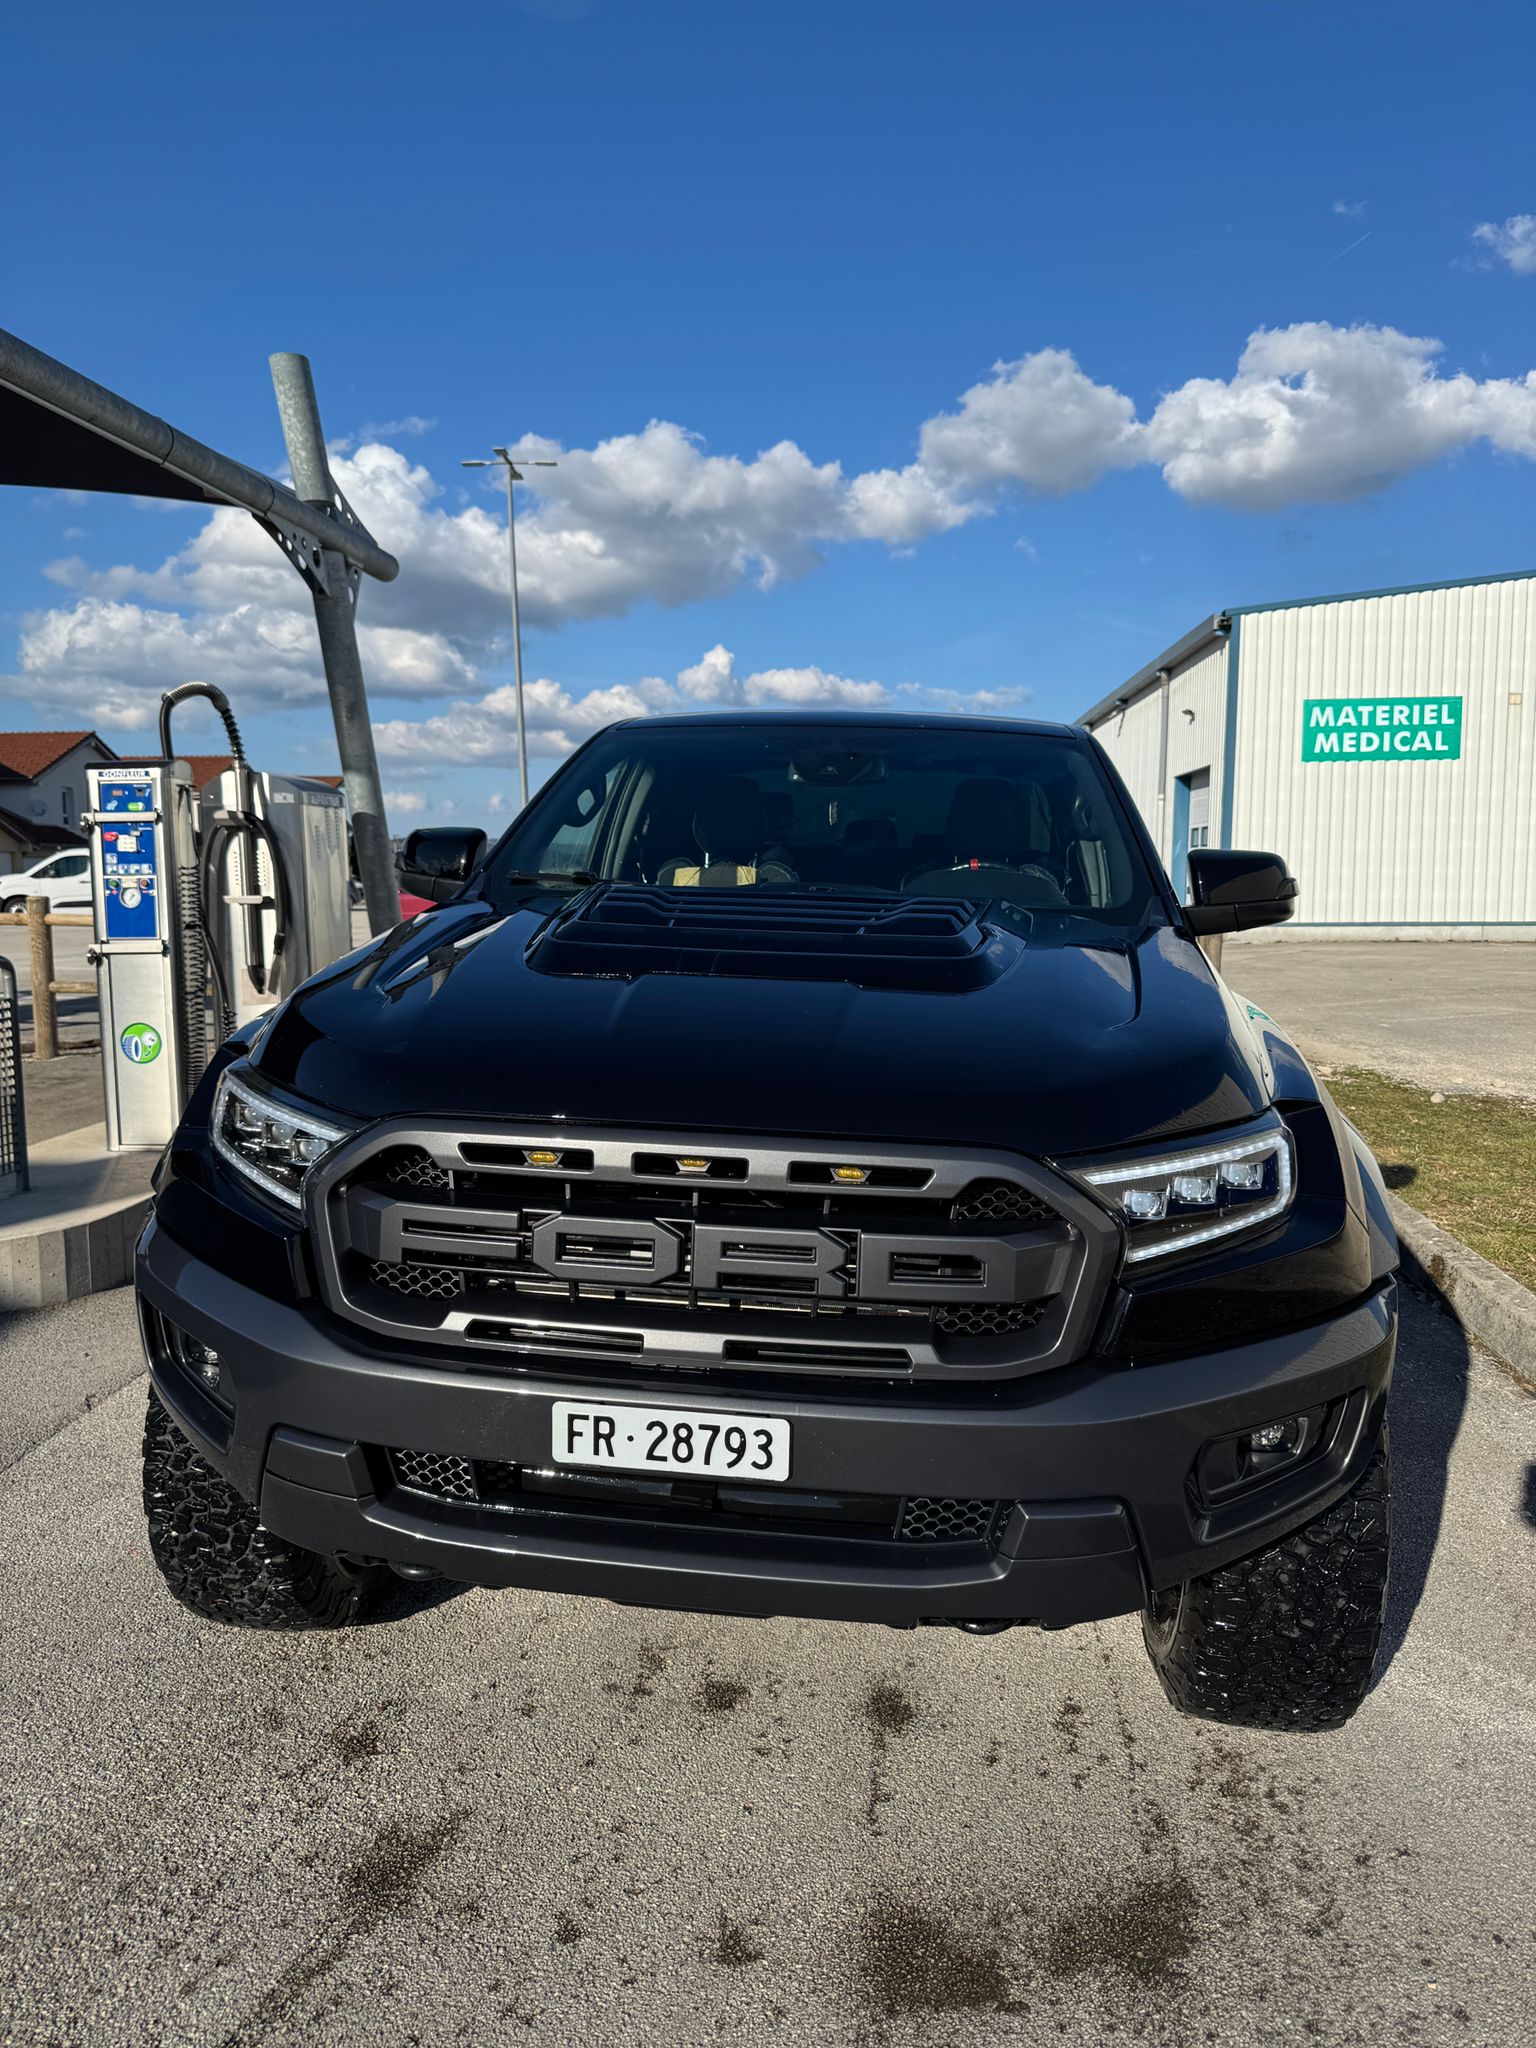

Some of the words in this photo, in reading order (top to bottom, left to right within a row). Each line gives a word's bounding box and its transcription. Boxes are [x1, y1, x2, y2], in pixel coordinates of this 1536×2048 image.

[1310, 704, 1455, 728] MATERIEL
[1314, 731, 1449, 753] MEDICAL
[376, 1202, 1022, 1303] FORD
